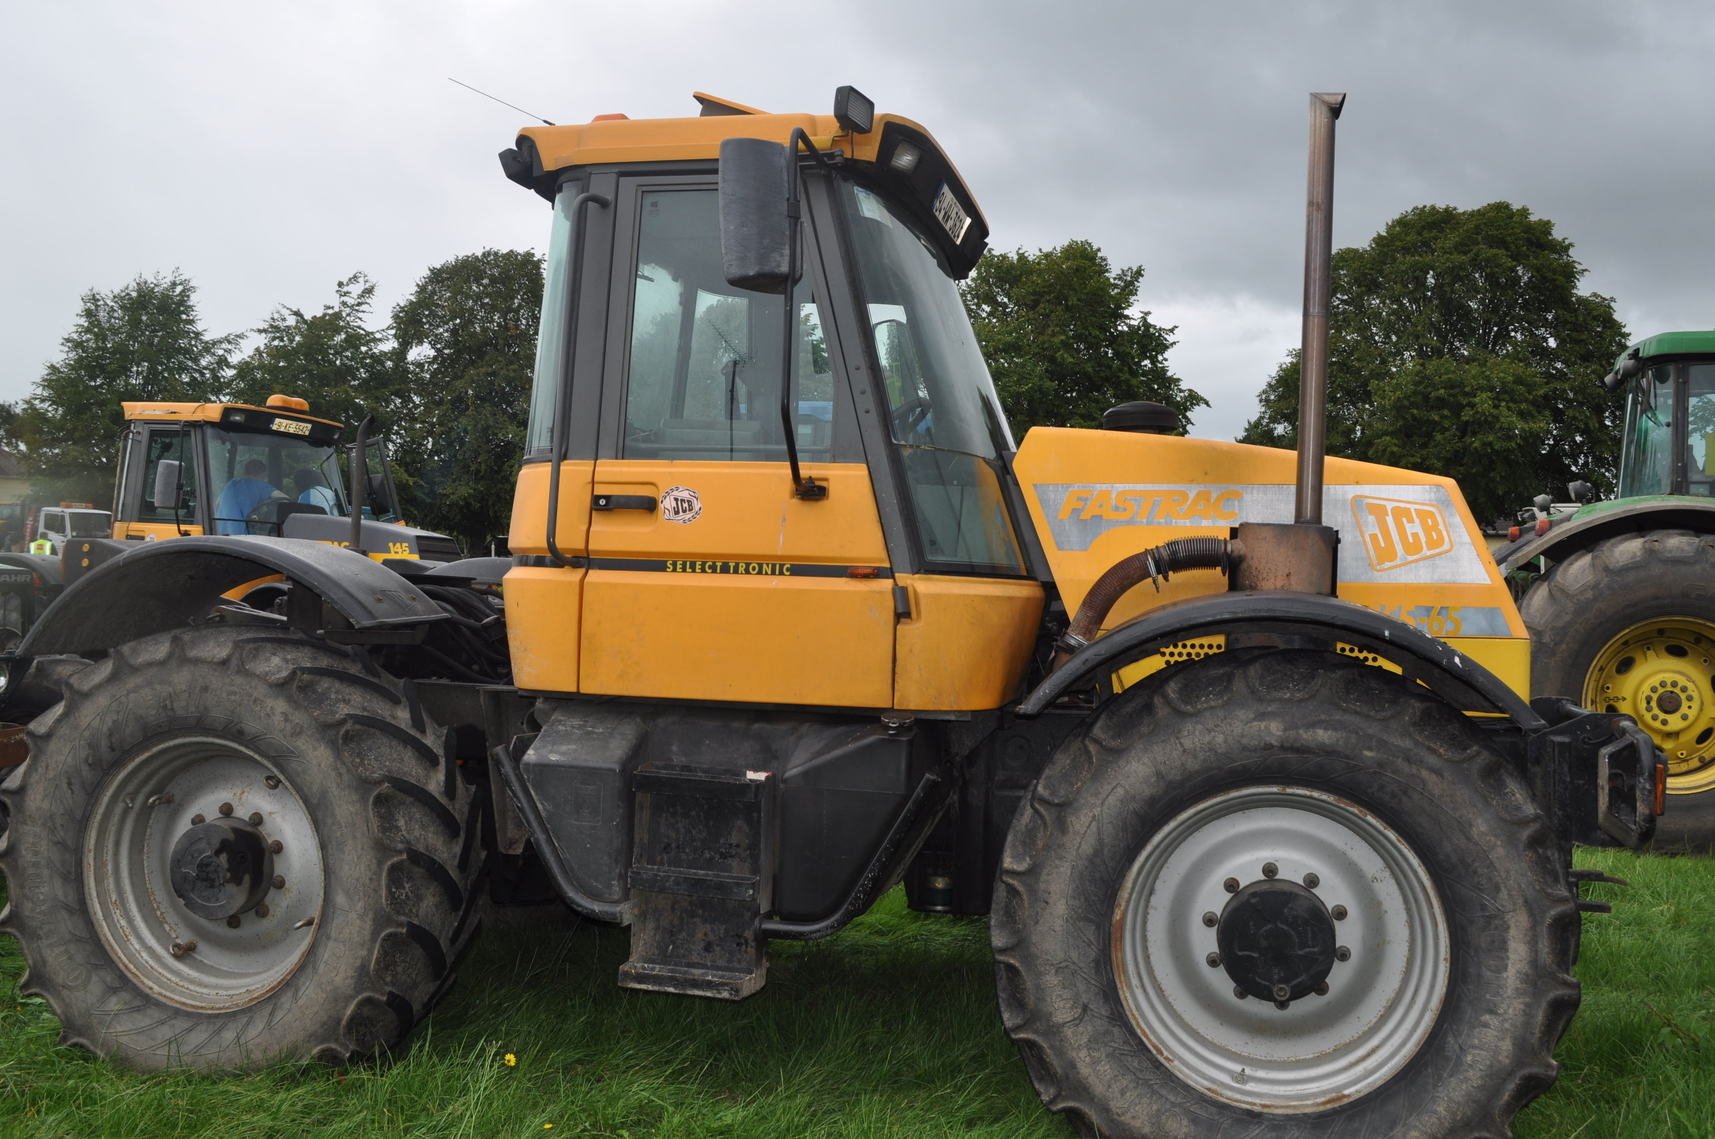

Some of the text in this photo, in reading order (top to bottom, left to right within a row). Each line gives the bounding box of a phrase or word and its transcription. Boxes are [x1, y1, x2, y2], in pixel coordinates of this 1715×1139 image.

[673, 497, 694, 516] JCB
[1057, 489, 1243, 520] FASTRAC
[1365, 502, 1446, 566] JCB
[387, 542, 410, 555] 145
